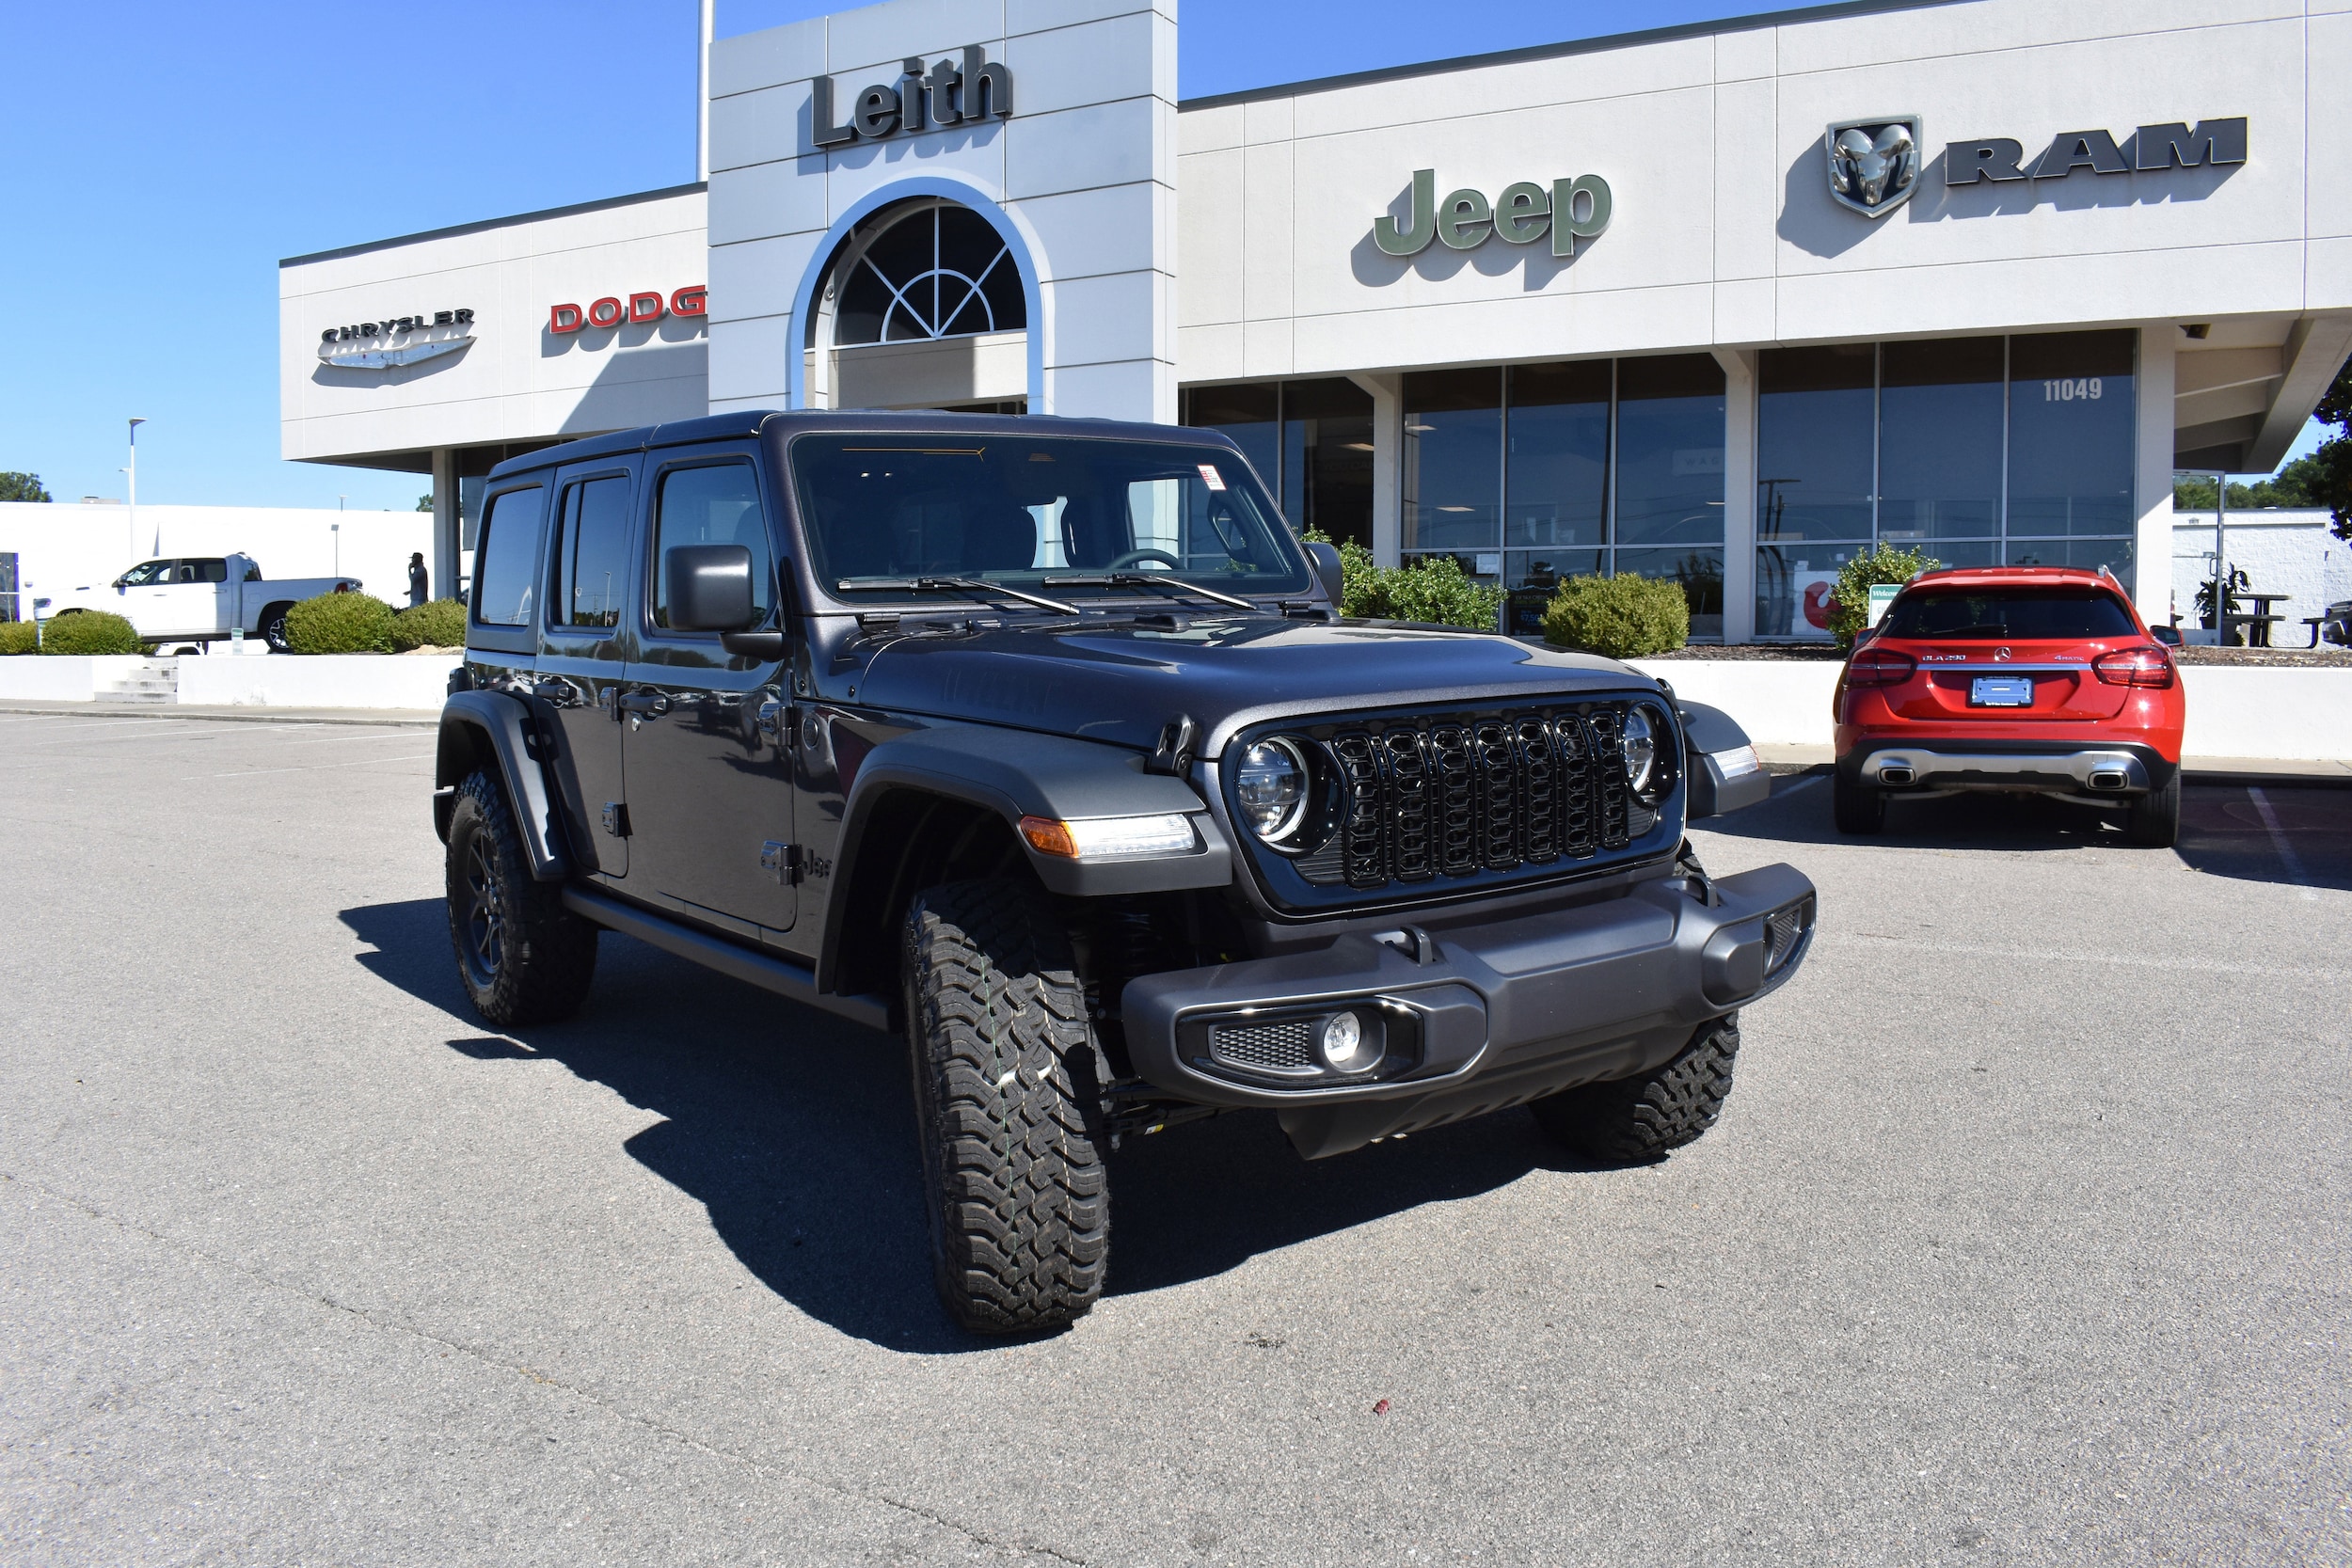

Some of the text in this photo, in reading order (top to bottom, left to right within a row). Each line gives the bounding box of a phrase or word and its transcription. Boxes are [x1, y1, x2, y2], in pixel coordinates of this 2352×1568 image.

[812, 45, 1013, 147] Leith
[1946, 116, 2248, 186] RAM
[1374, 167, 1613, 257] Jeep
[321, 308, 475, 343] CHRYSLER
[550, 284, 707, 334] DODG
[2043, 377, 2103, 402] 11049
[803, 847, 833, 879] Jee
